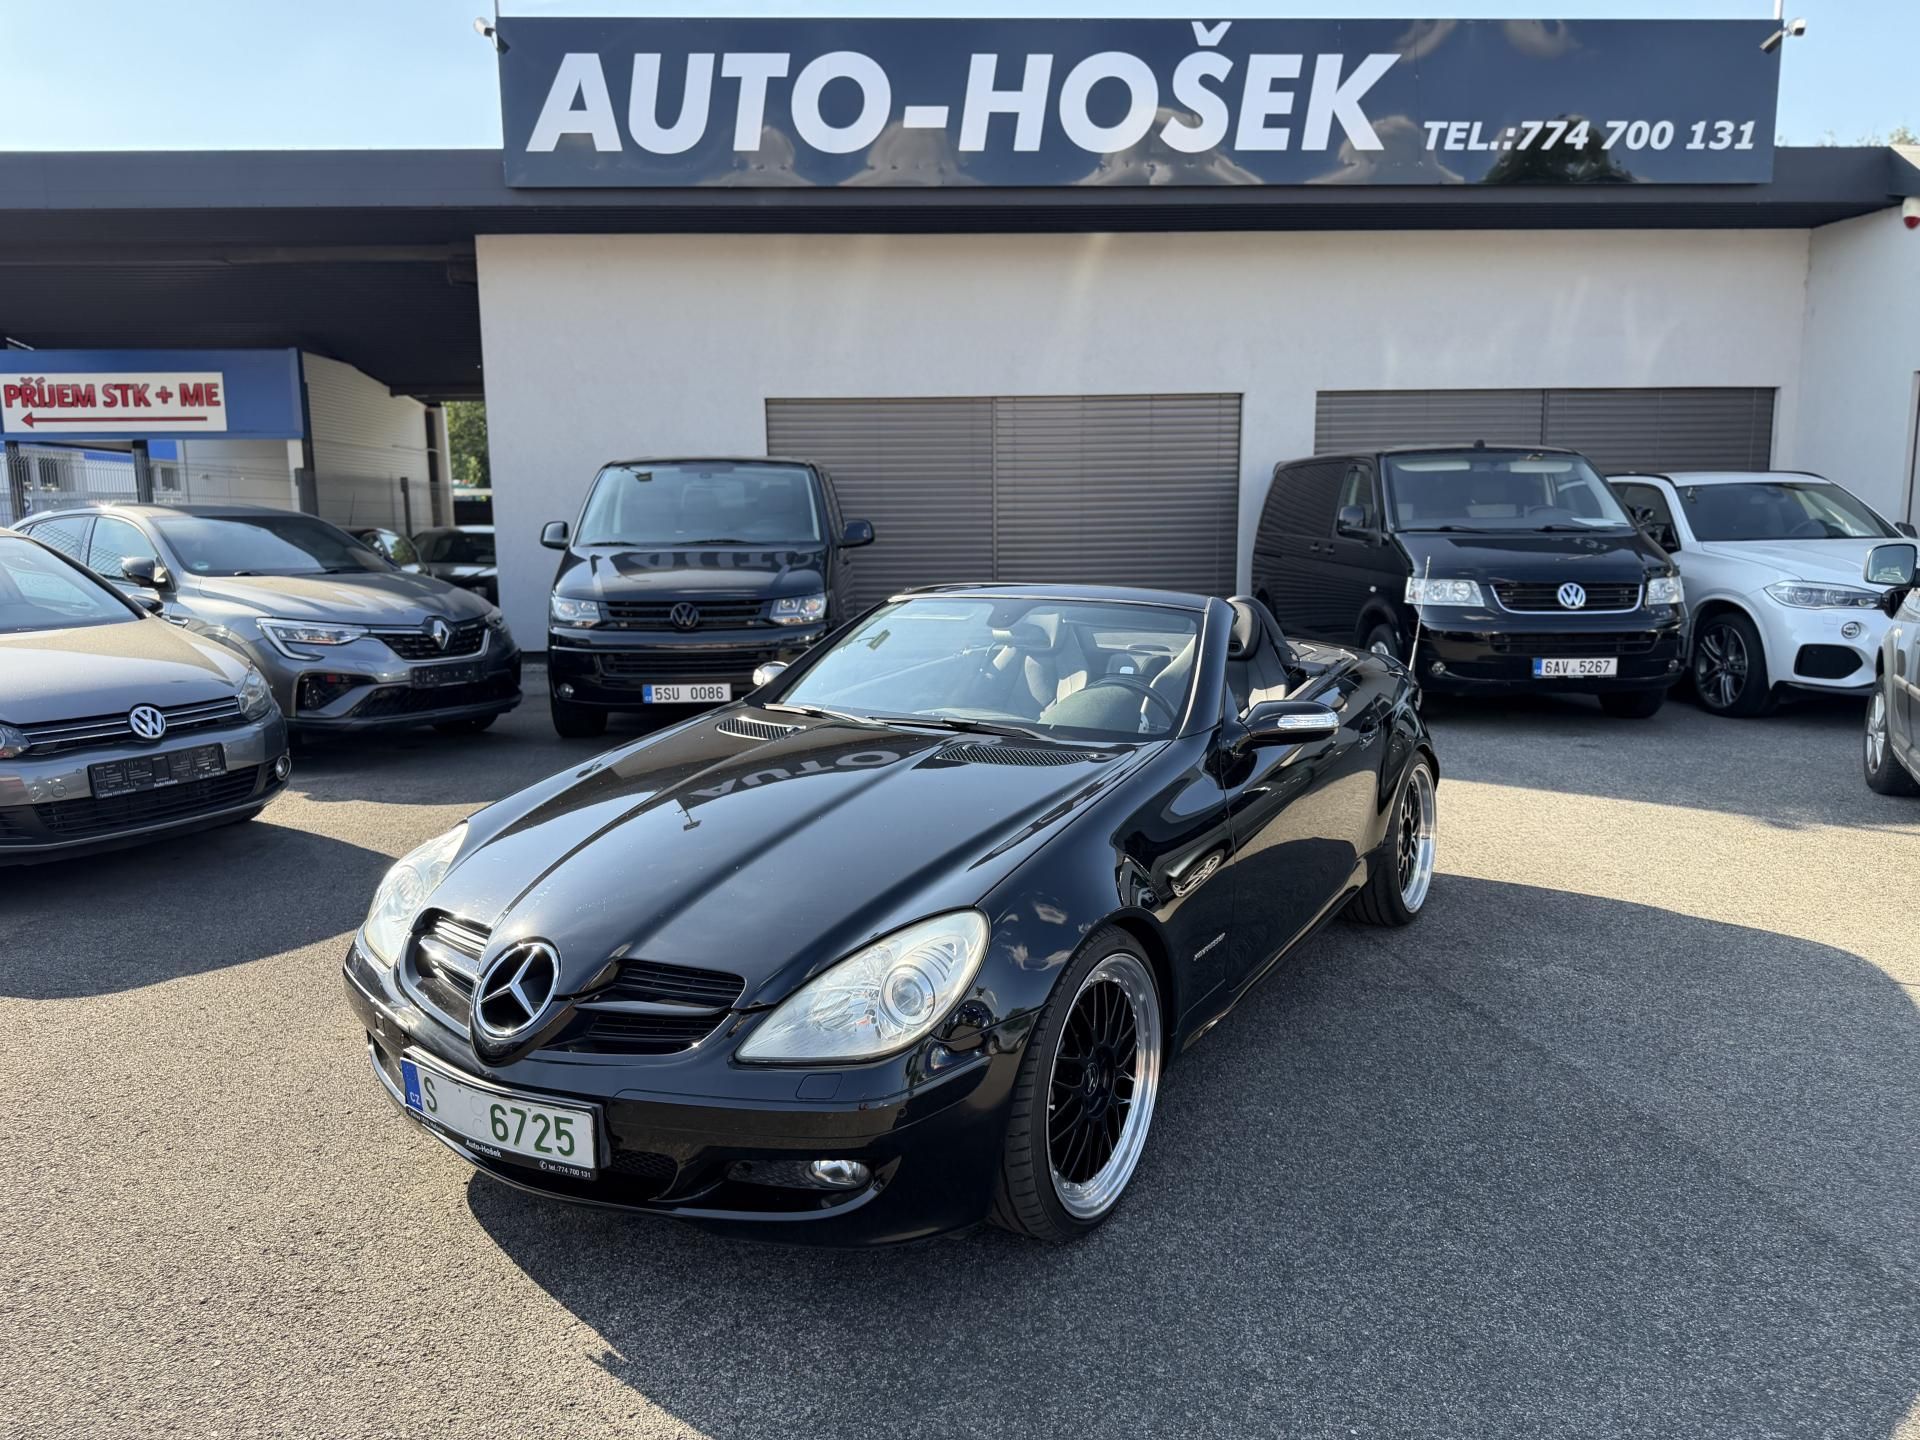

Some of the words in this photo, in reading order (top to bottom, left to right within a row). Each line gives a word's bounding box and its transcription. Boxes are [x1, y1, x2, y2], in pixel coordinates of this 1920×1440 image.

[526, 21, 1401, 154] AUTO-HOŠEK
[1423, 120, 1588, 151] TEL.:774
[1600, 120, 1673, 151] 700
[1686, 120, 1754, 151] 131
[3, 377, 97, 407] PŘÍJEM
[102, 384, 151, 407] STK
[155, 386, 173, 404] +
[178, 383, 221, 406] ME
[1545, 661, 1569, 674] 6AV
[1579, 660, 1611, 673] 5267
[655, 687, 680, 701] 5SU
[690, 687, 724, 700] 0086
[410, 1092, 422, 1105] CZ
[423, 1077, 437, 1112] S
[490, 1104, 574, 1156] 6725
